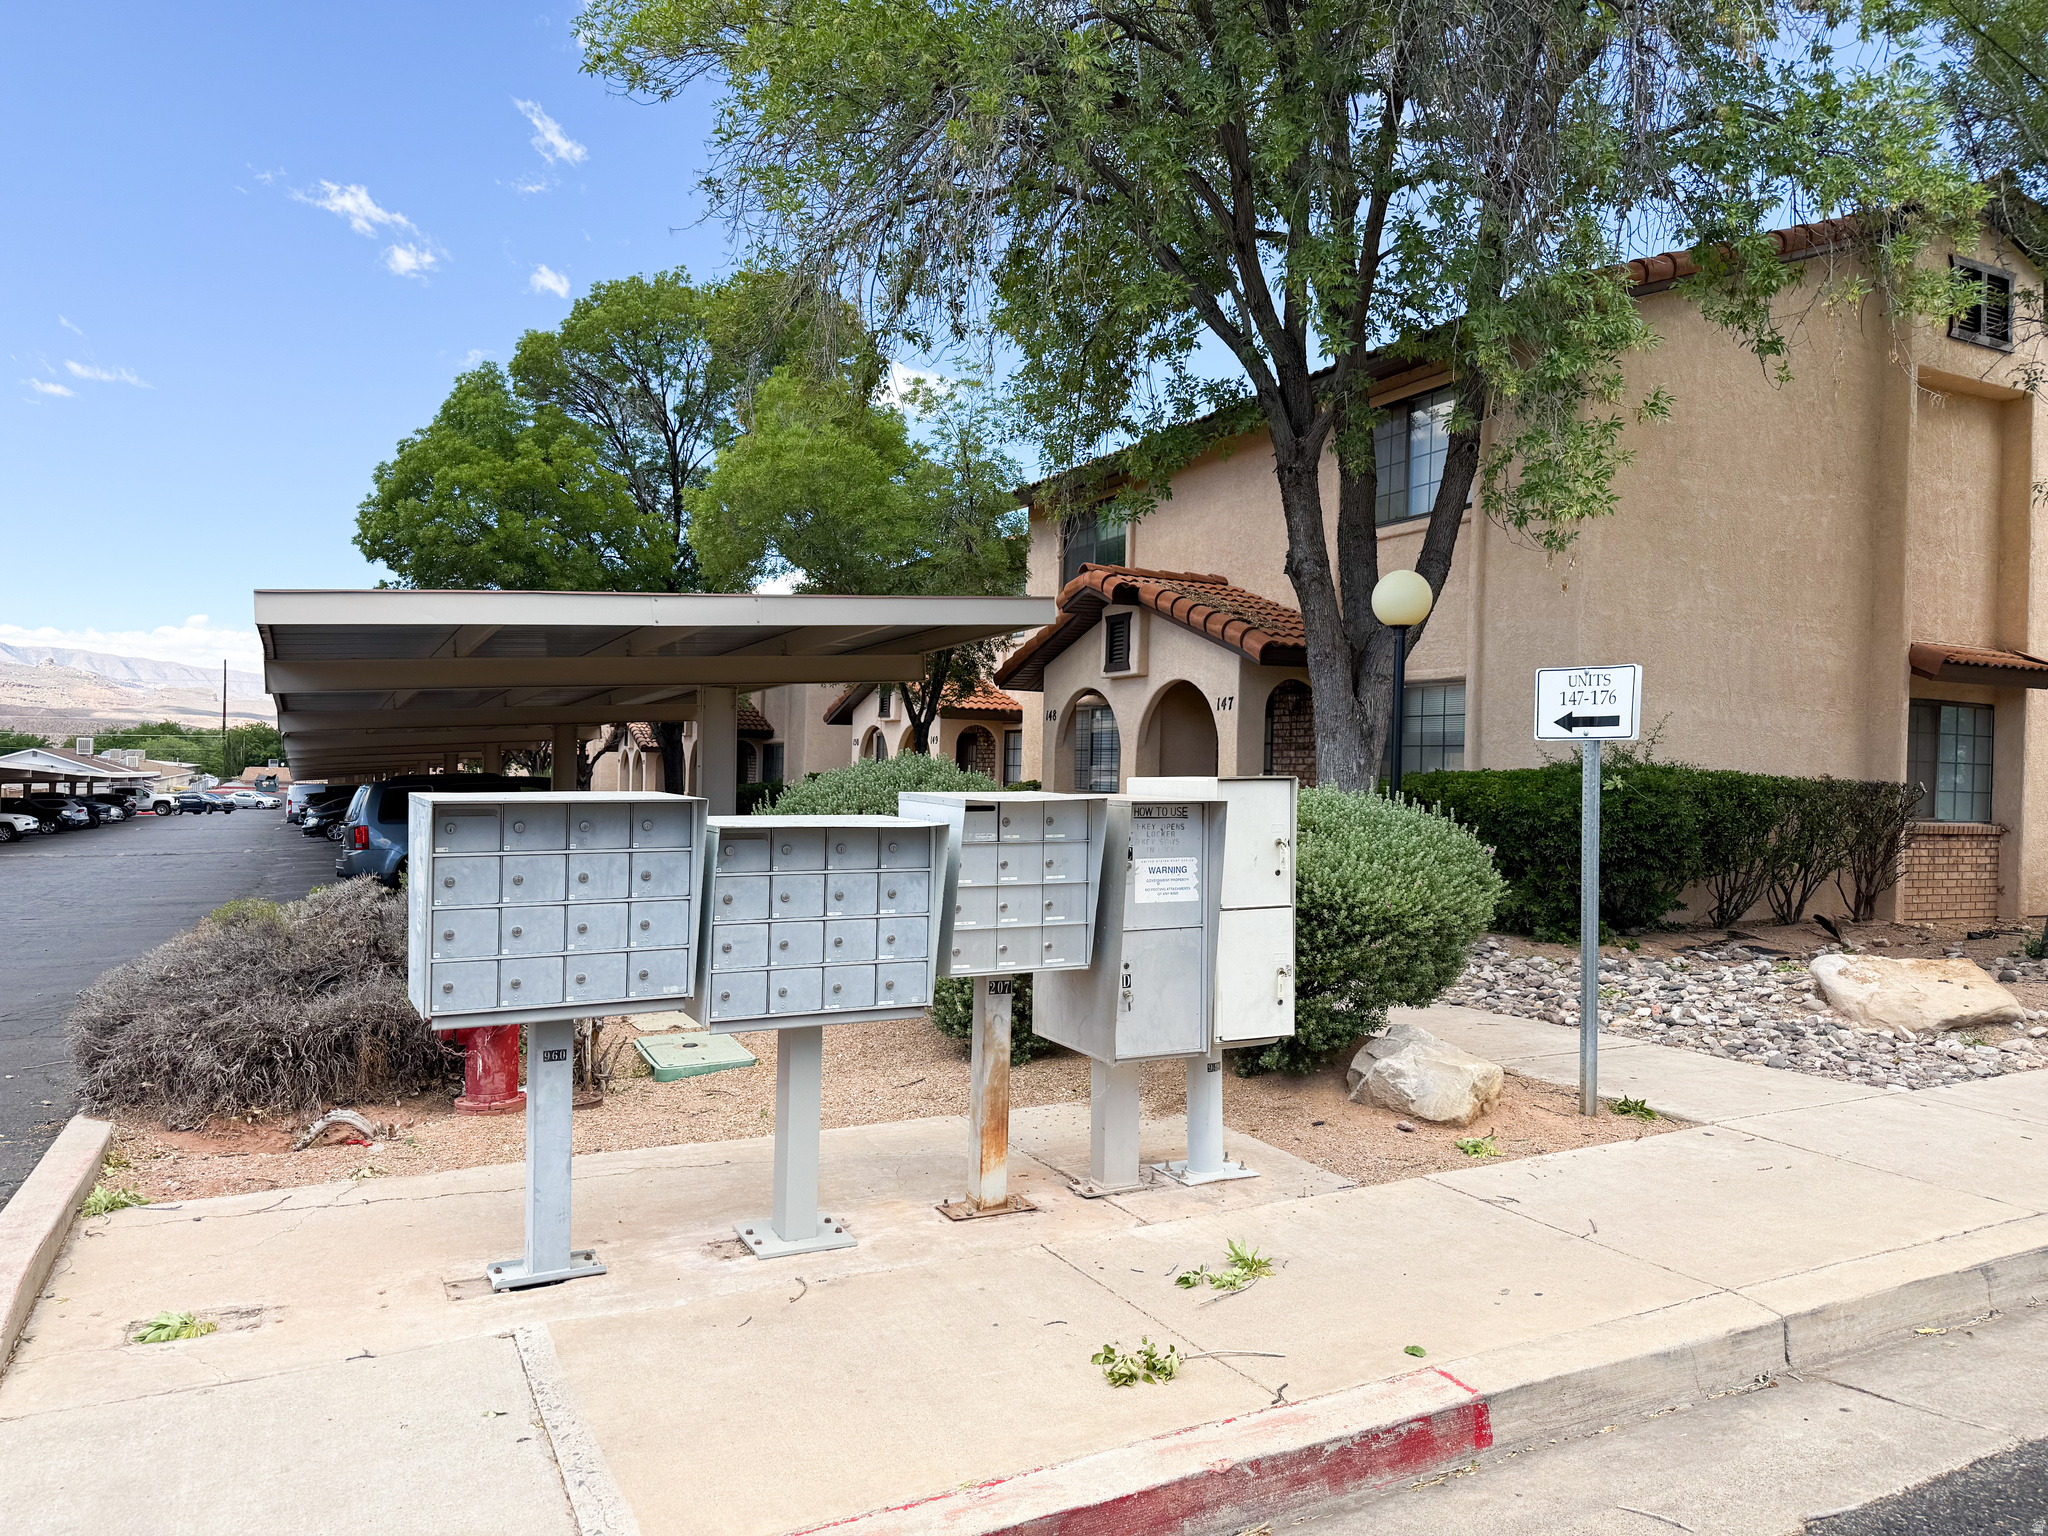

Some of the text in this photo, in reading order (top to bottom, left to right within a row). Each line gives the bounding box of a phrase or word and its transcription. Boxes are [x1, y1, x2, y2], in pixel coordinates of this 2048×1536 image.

[1568, 673, 1611, 687] UNITS
[1216, 696, 1234, 711] 147
[1560, 689, 1617, 706] 147-176
[1045, 709, 1057, 722] 148
[1134, 806, 1189, 817] HOW TO USE
[1148, 866, 1188, 874] WARNING
[990, 981, 1010, 994] 207
[1123, 974, 1131, 988] D
[544, 1050, 566, 1061] 960
